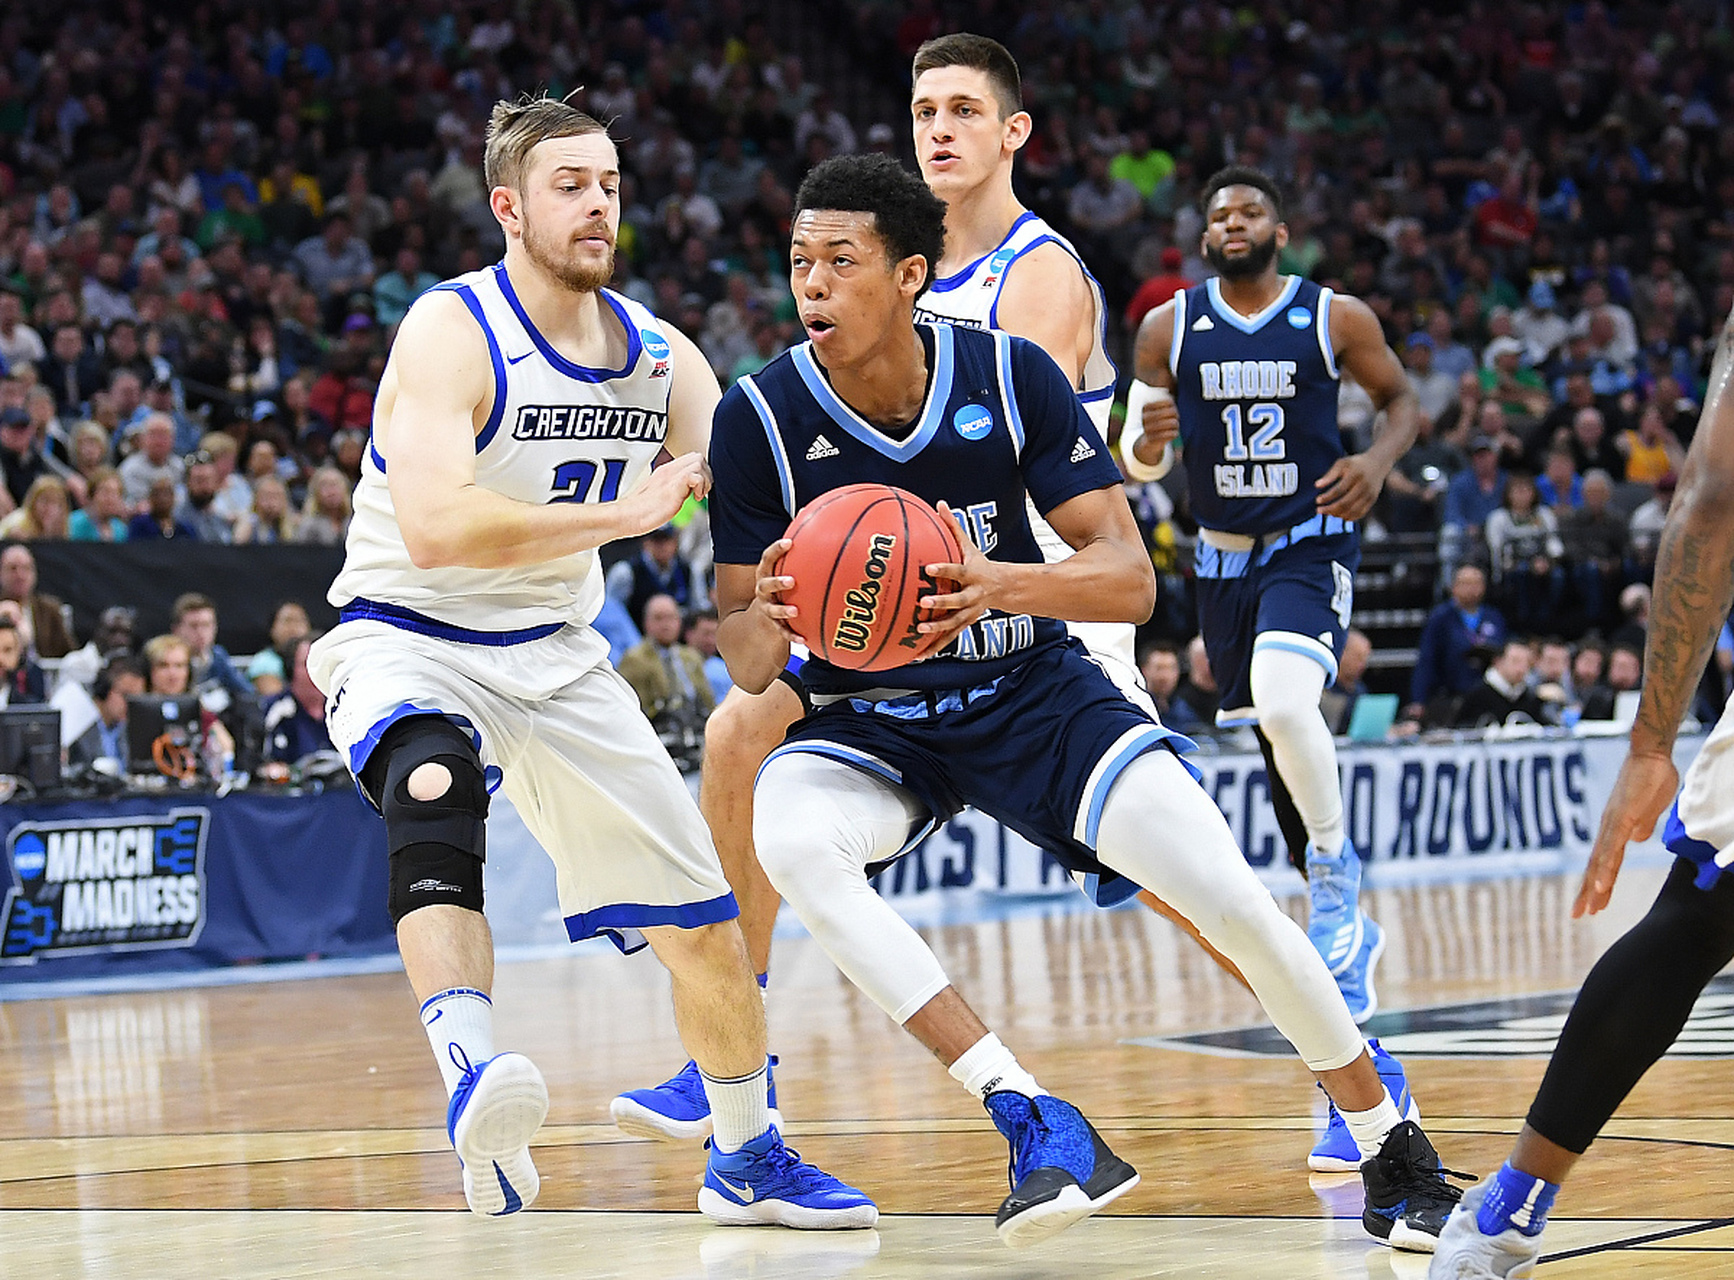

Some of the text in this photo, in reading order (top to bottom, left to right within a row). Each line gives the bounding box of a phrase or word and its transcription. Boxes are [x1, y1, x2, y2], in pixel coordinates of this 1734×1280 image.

[1199, 360, 1297, 400] RHODE
[512, 404, 668, 442] CREIGHTON
[1221, 403, 1286, 461] 12
[805, 447, 840, 461] adidas
[1213, 462, 1299, 498] ISLAND
[546, 458, 628, 505] 21
[832, 533, 897, 653] Wilson
[1390, 752, 1591, 860] ROUNDS
[45, 826, 154, 883] MARCH
[61, 874, 198, 932] MADNESS
